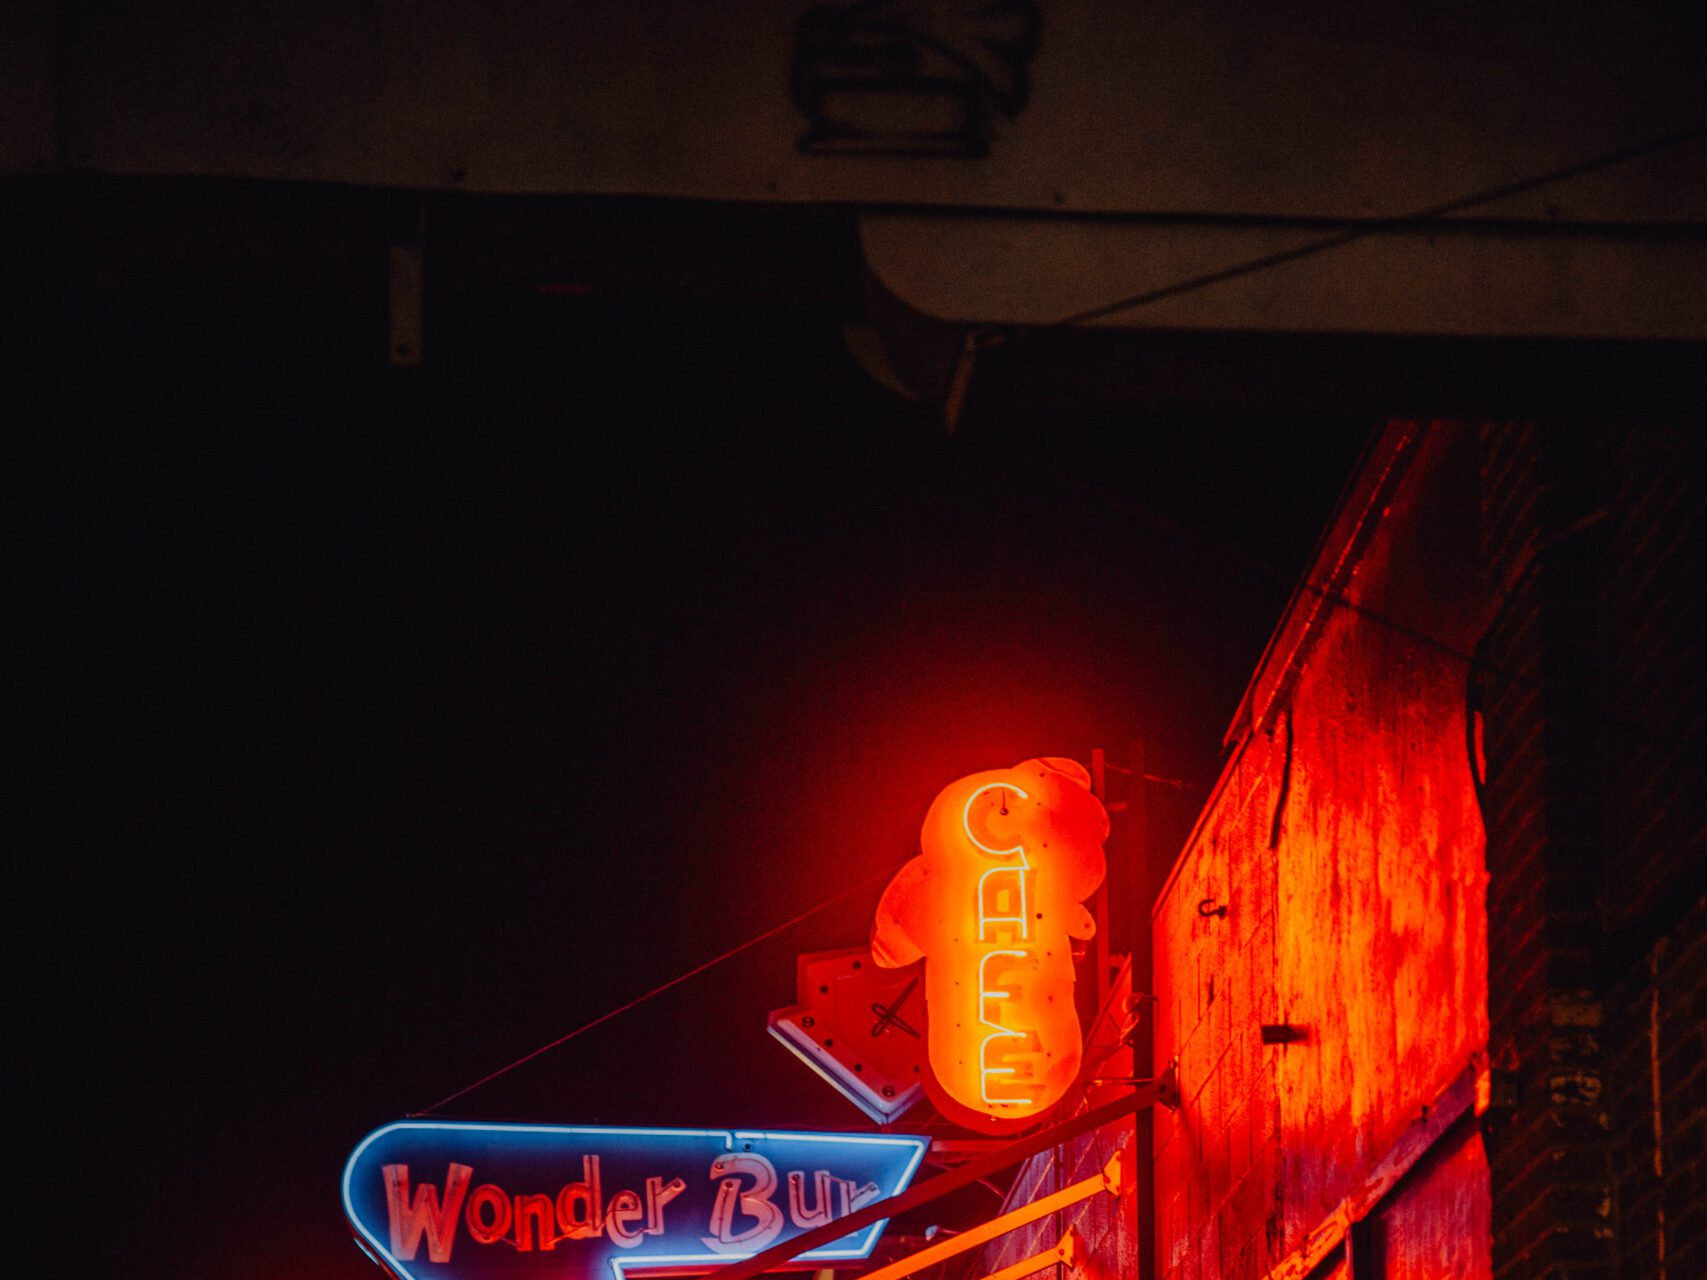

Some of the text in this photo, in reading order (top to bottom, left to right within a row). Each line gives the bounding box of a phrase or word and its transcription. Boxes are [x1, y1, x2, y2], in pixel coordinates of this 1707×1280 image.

[962, 780, 1038, 1105] CAFE
[381, 1152, 881, 1264] Wonder Bur
